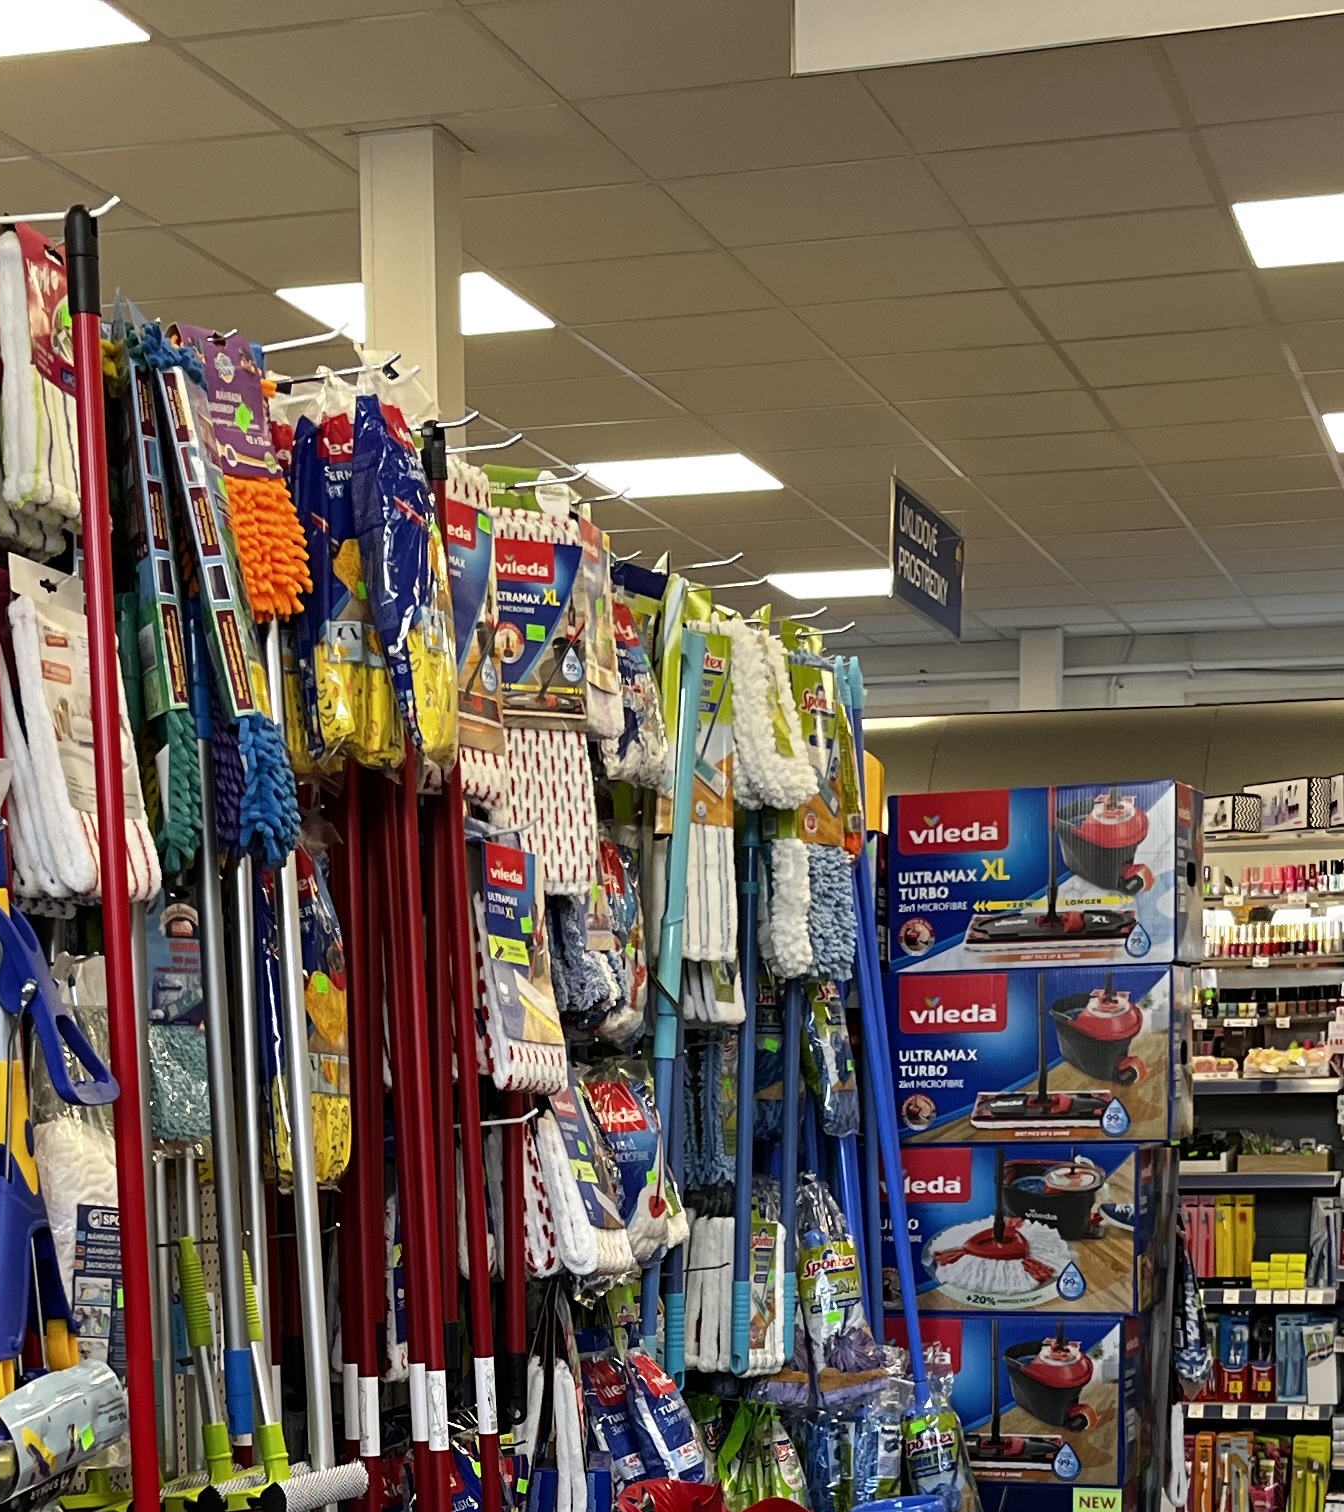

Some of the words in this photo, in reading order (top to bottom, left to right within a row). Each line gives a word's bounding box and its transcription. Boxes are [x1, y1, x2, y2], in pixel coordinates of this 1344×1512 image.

[899, 496, 938, 557] ÚKLIDOVÉ
[496, 560, 549, 577] vileda
[898, 546, 949, 606] PROSTŘEDKY
[497, 590, 541, 605] LTRAMAX
[542, 588, 561, 606] XL
[908, 820, 999, 845] vileda
[490, 865, 524, 885] vileda
[898, 868, 977, 884] ULTRAMAX
[980, 858, 1010, 881] XL
[898, 886, 949, 901] TURBO
[916, 900, 968, 912] MICROFIBRE
[909, 1003, 998, 1025] vileda
[899, 1048, 978, 1063] ULTRAMAX
[899, 1064, 948, 1077] TURBO
[916, 1077, 965, 1088] MICROFIBRE
[1078, 1496, 1117, 1510] NEW
